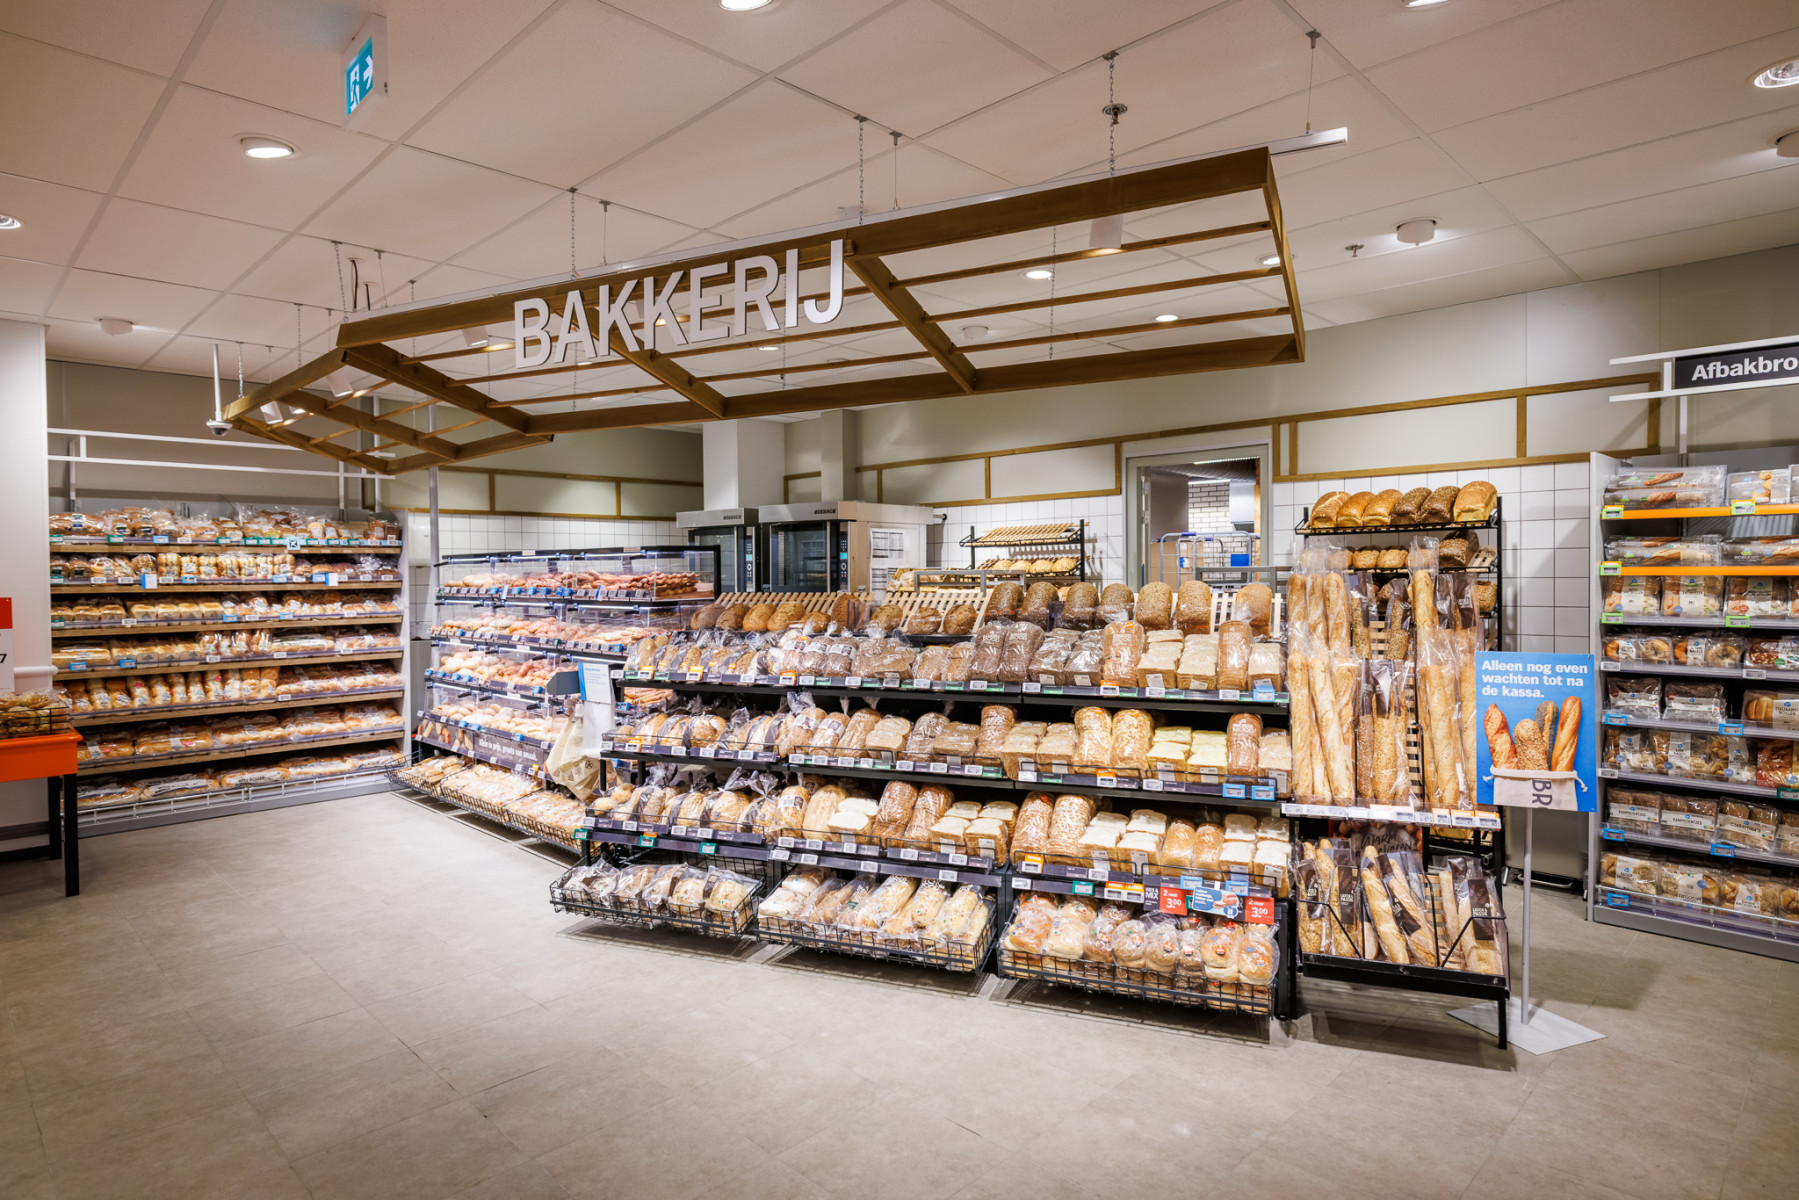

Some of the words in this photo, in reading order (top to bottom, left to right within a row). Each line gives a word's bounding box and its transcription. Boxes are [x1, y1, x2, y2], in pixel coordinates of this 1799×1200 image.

[514, 239, 843, 369] BAKKERIJ
[1691, 356, 1799, 381] Afbakbro
[1482, 660, 1522, 672] Alleen
[1527, 663, 1552, 675] nog
[1555, 664, 1588, 674] even
[1482, 673, 1539, 685] wachten
[1543, 675, 1563, 686] tot
[1566, 678, 1584, 687] na
[1482, 685, 1498, 696] de
[1502, 685, 1544, 698] kassa.
[1146, 892, 1159, 900] MIX
